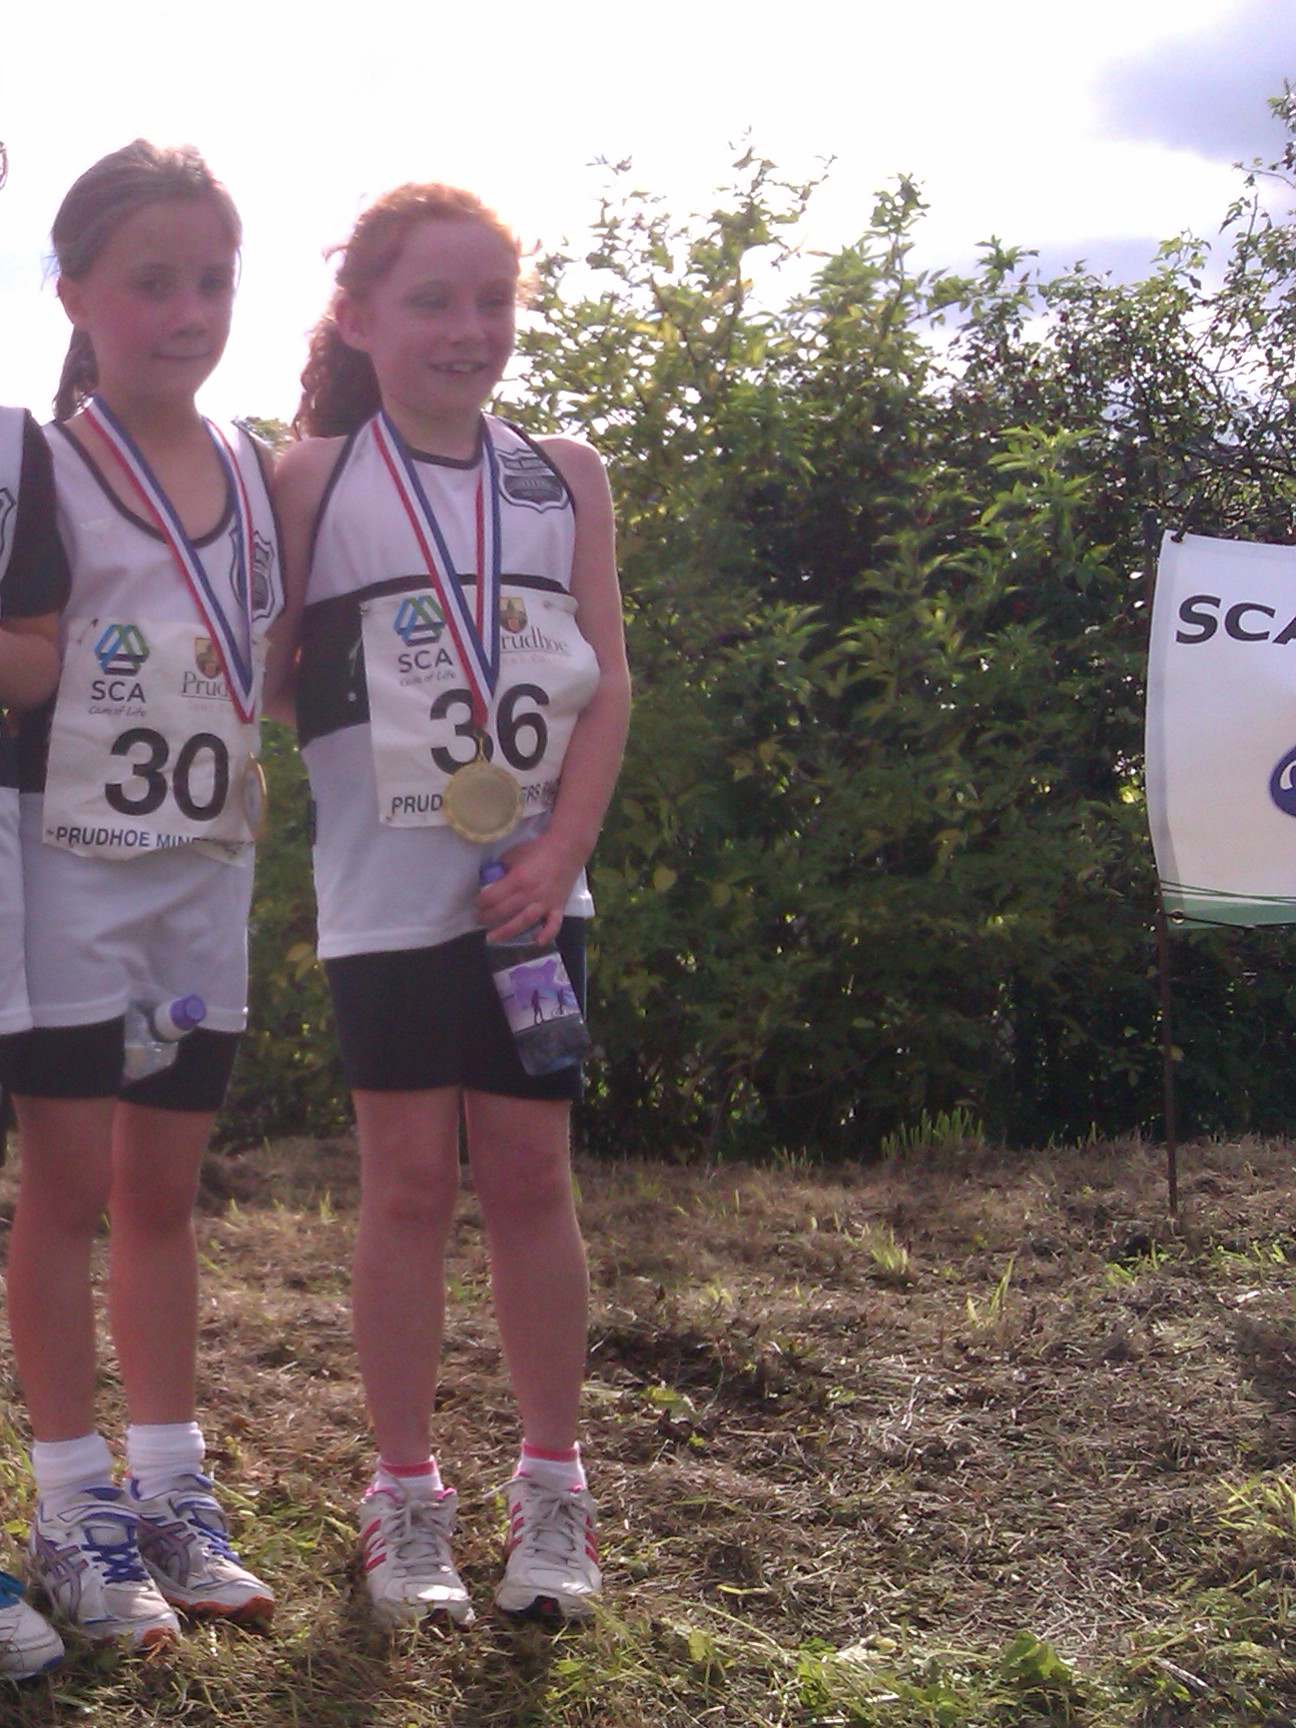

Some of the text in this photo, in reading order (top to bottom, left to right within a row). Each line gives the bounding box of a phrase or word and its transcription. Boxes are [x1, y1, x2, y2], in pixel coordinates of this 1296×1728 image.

[502, 626, 569, 652] rudhoe
[398, 648, 454, 673] SCA
[90, 680, 146, 703] SCA
[430, 683, 551, 775] 36
[105, 727, 229, 822] 30
[56, 826, 150, 848] PRUDHOE
